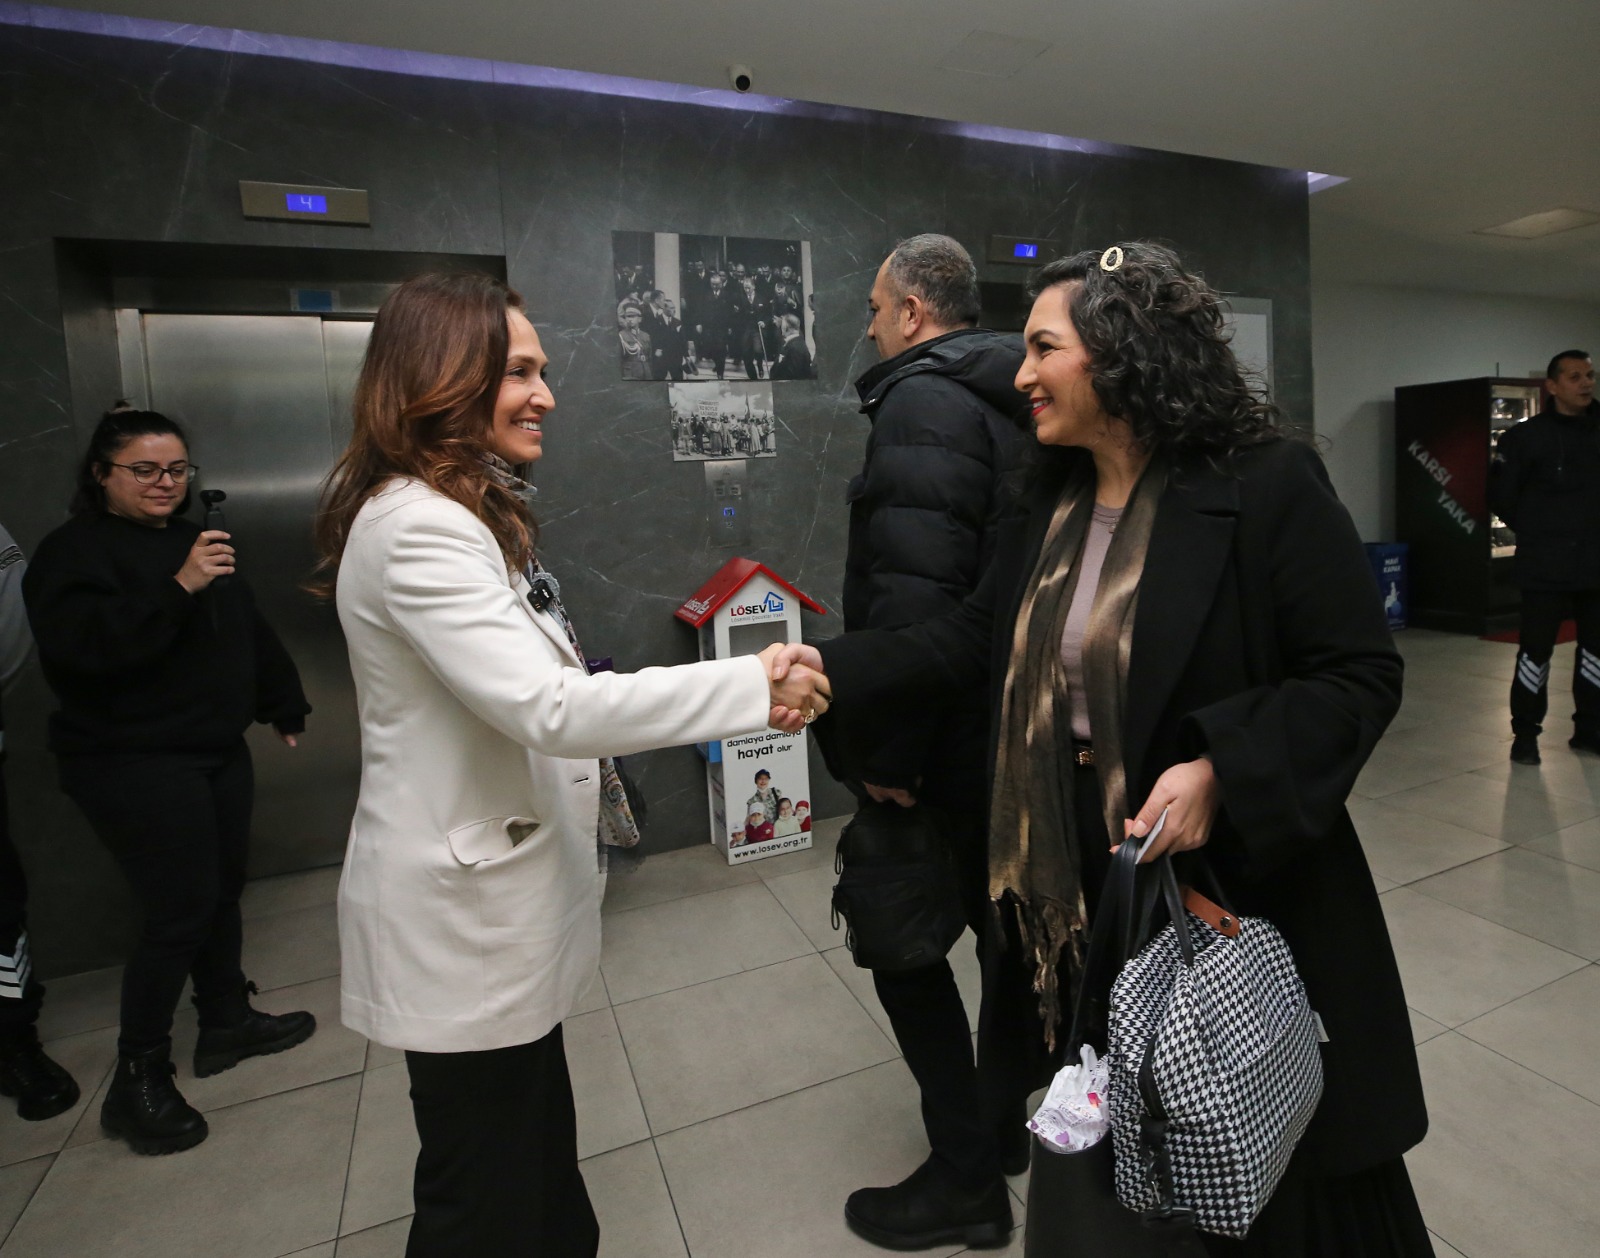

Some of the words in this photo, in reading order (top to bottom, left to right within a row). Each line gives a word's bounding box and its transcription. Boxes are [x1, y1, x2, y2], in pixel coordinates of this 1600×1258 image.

[300, 195, 313, 210] 4
[1408, 440, 1453, 486] KARSI
[1438, 490, 1476, 534] YAKA
[731, 604, 767, 616] LÖSEV
[727, 735, 764, 748] damlaya
[738, 744, 773, 759] hayat
[777, 744, 793, 753] olur
[734, 837, 808, 858] www.losev.org.tr
